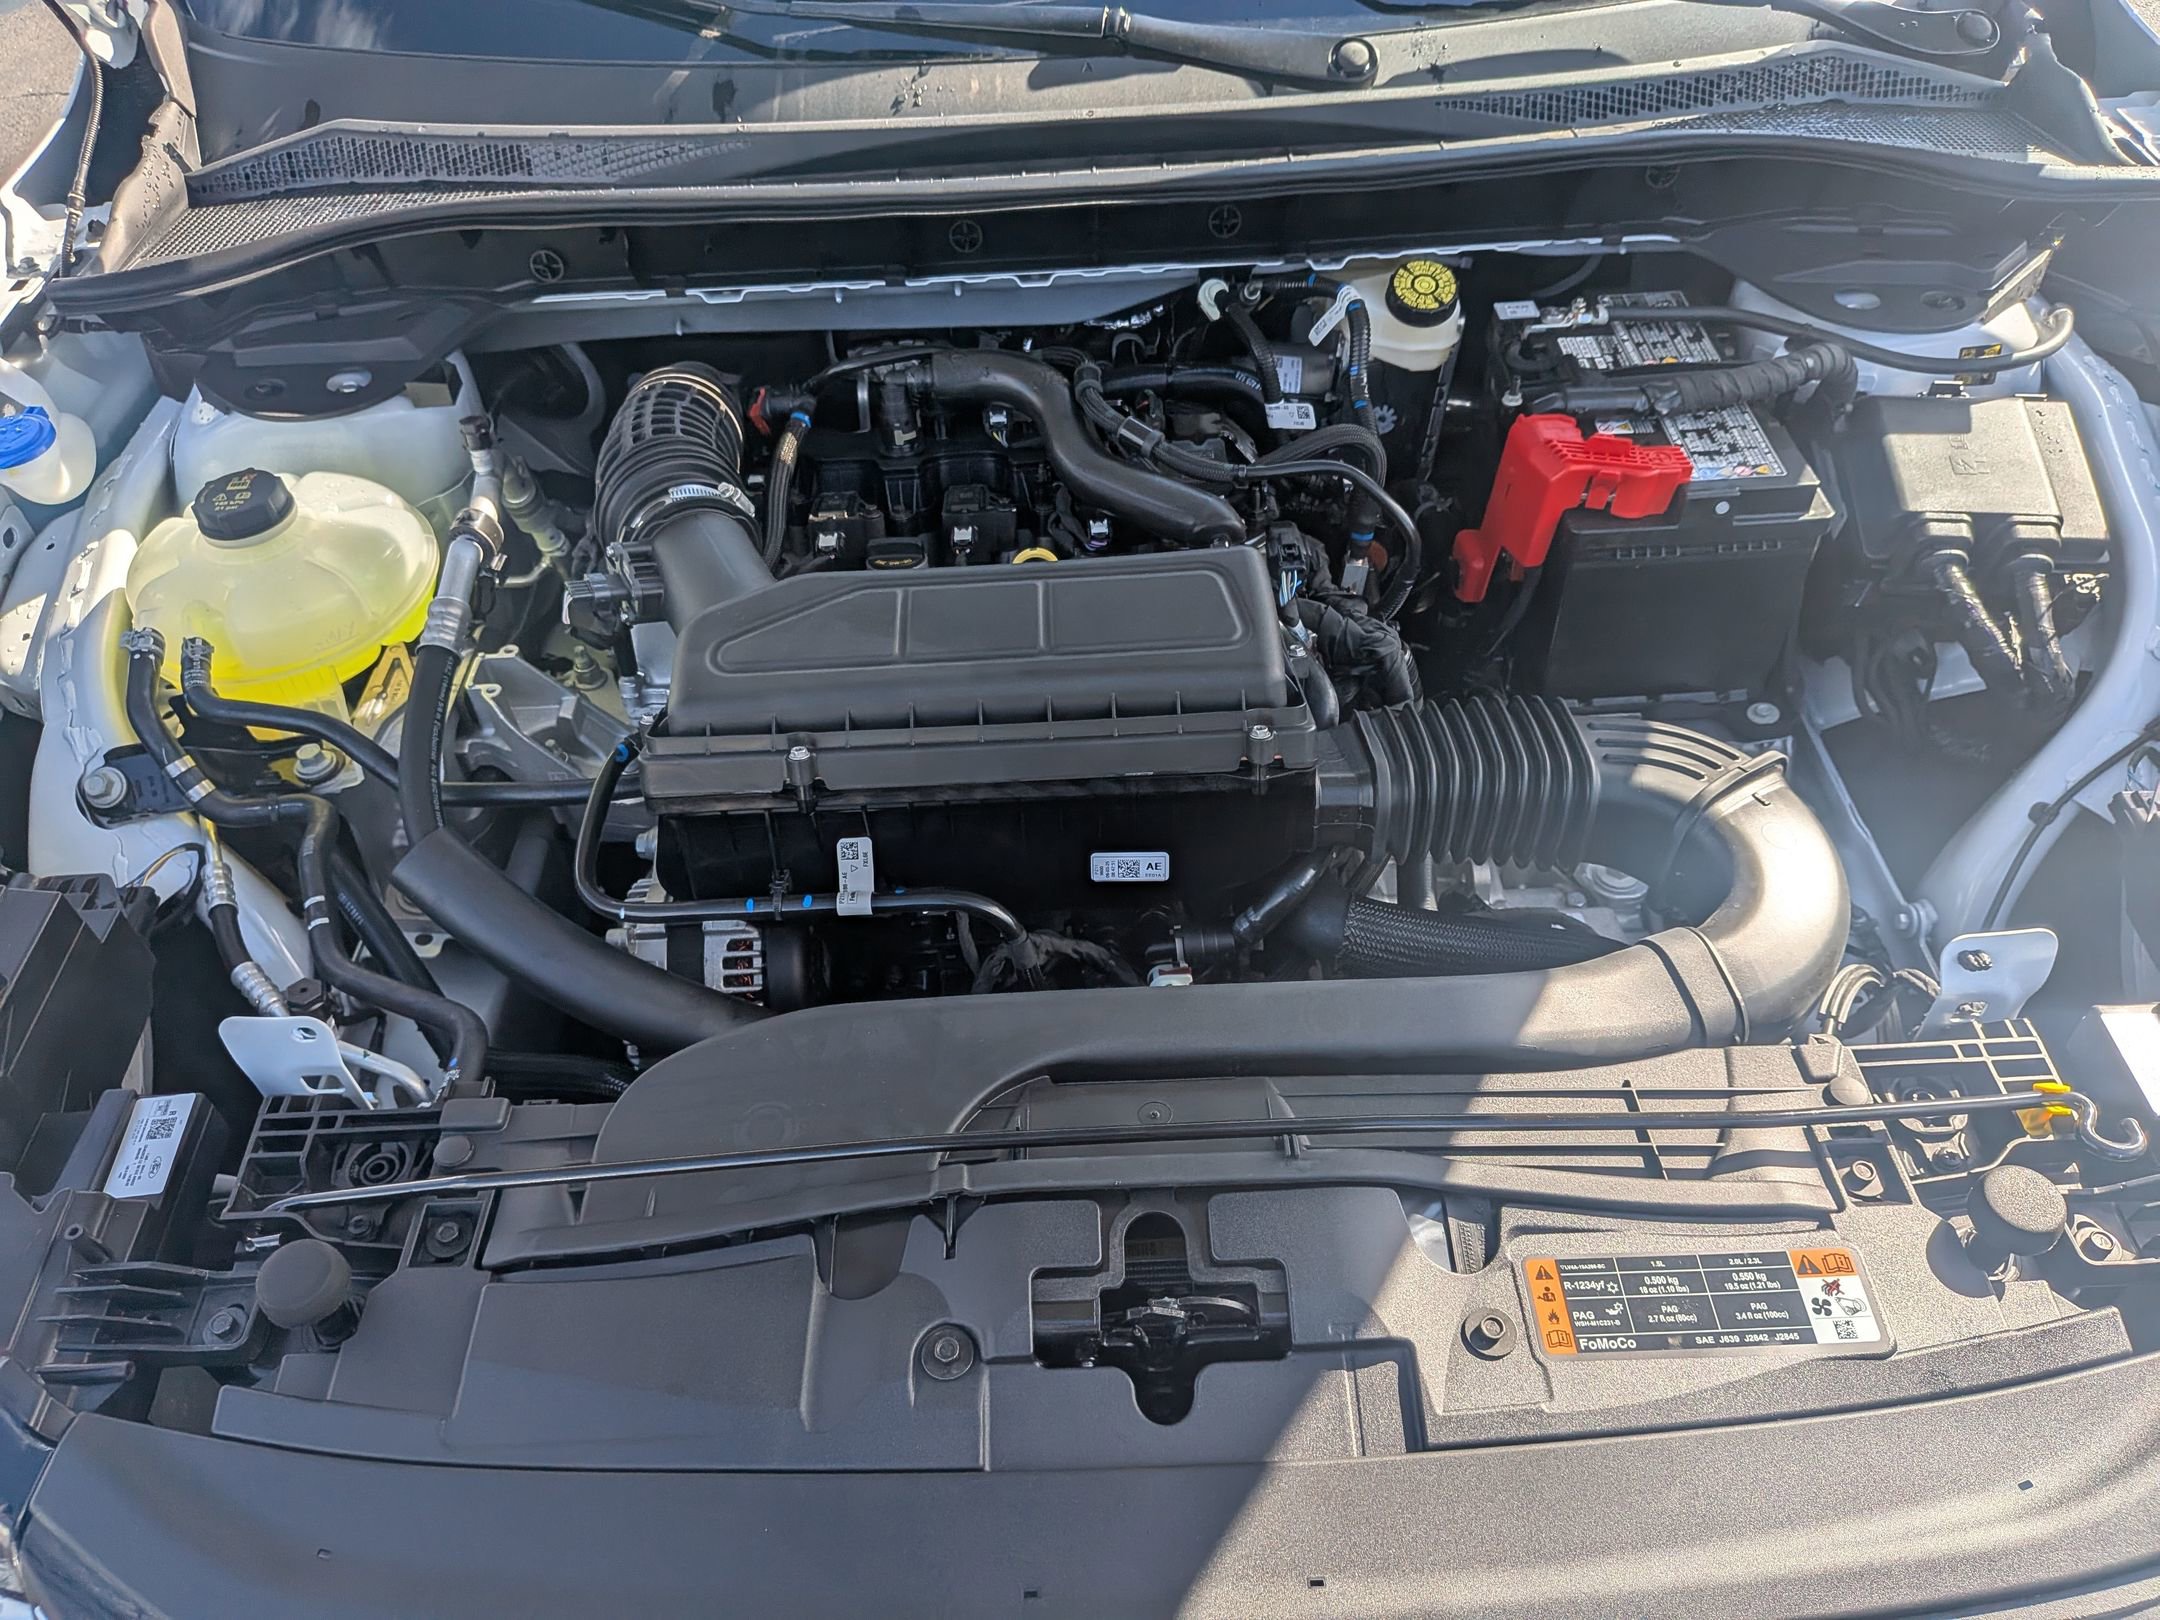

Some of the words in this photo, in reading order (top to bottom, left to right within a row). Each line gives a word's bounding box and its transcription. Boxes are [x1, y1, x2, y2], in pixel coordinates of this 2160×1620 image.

[1146, 862, 1162, 871] AE
[1644, 1276, 1667, 1285] 0.500
[1667, 1276, 1679, 1286] kg
[1732, 1272, 1755, 1281] 0.550
[1755, 1272, 1767, 1282] kg
[1563, 1281, 1605, 1291] R-1234yf
[1676, 1285, 1690, 1293] lbs)
[1750, 1282, 1766, 1290] (1.21
[1767, 1281, 1780, 1289] lbs)
[1572, 1311, 1595, 1320] PAG
[1763, 1311, 1789, 1320] (100cc)
[1719, 1335, 1740, 1344] J639
[1774, 1332, 1799, 1341] J2845
[1579, 1337, 1637, 1350] FoMoCo
